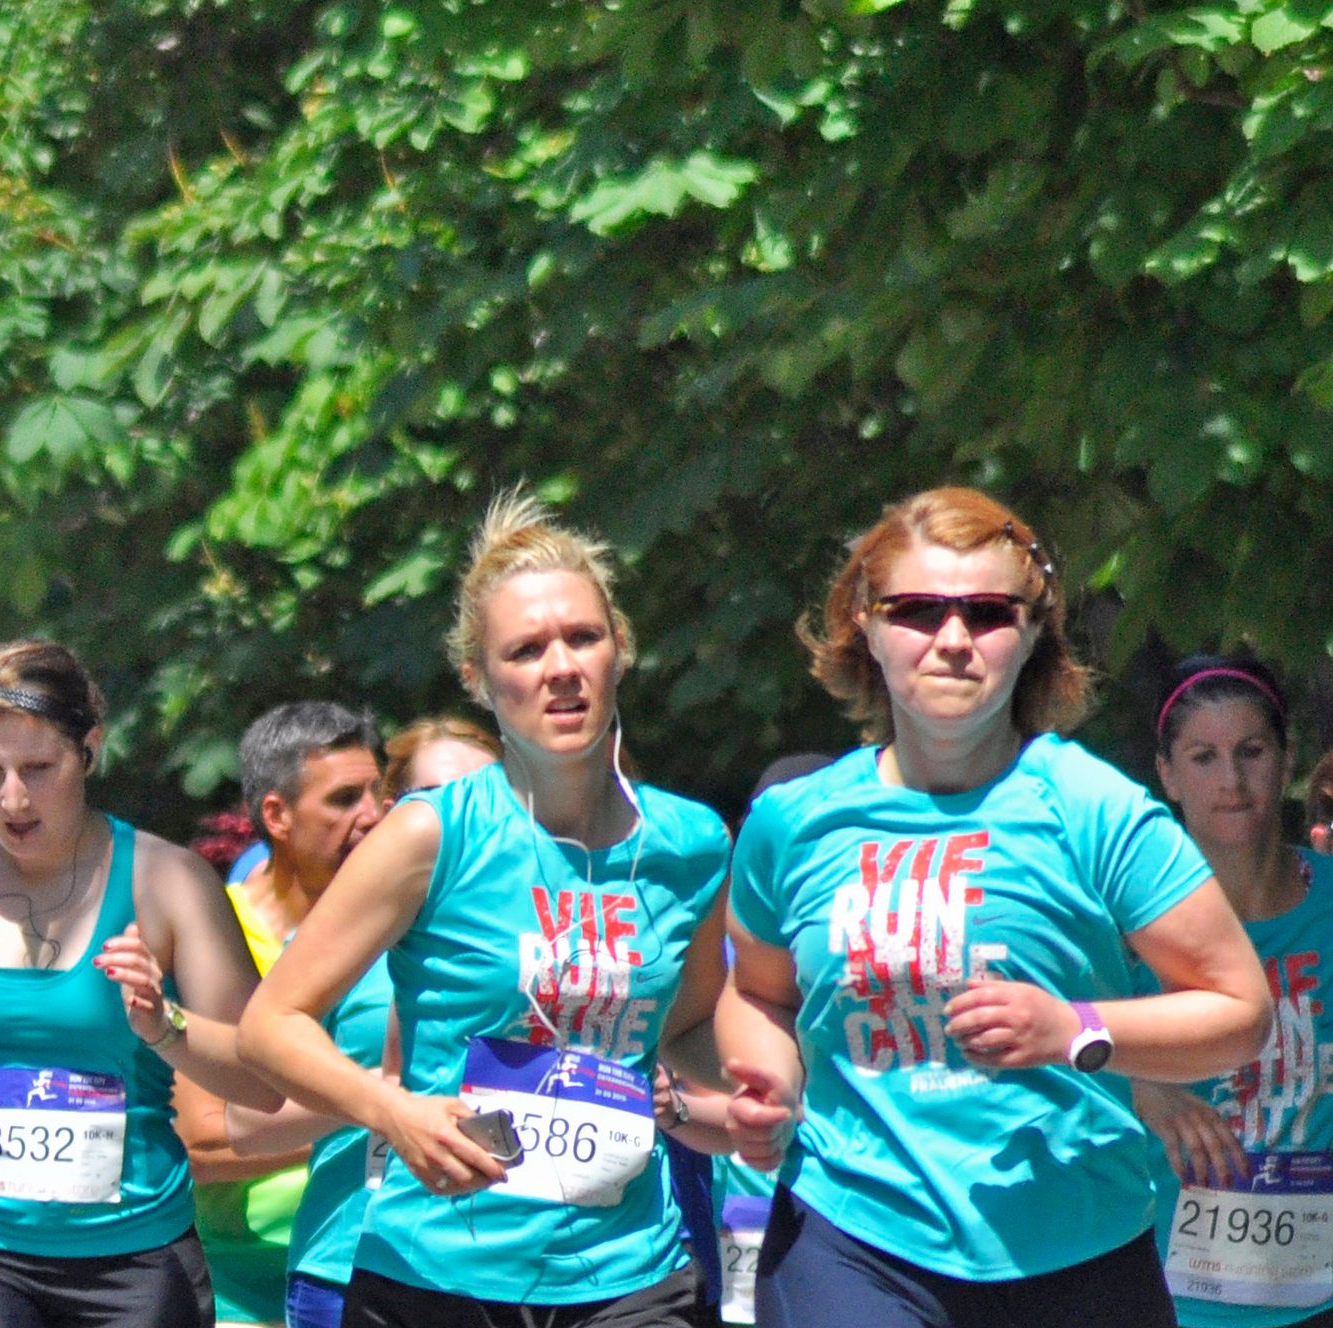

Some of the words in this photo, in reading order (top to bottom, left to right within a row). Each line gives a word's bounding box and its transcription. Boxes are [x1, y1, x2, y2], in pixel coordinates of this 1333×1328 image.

[828, 876, 967, 954] RUN
[518, 932, 630, 999] RUN
[843, 1002, 949, 1078] CIT
[519, 1112, 599, 1164] 586
[608, 1129, 641, 1148] 10K-G
[1178, 1199, 1295, 1246] 21936
